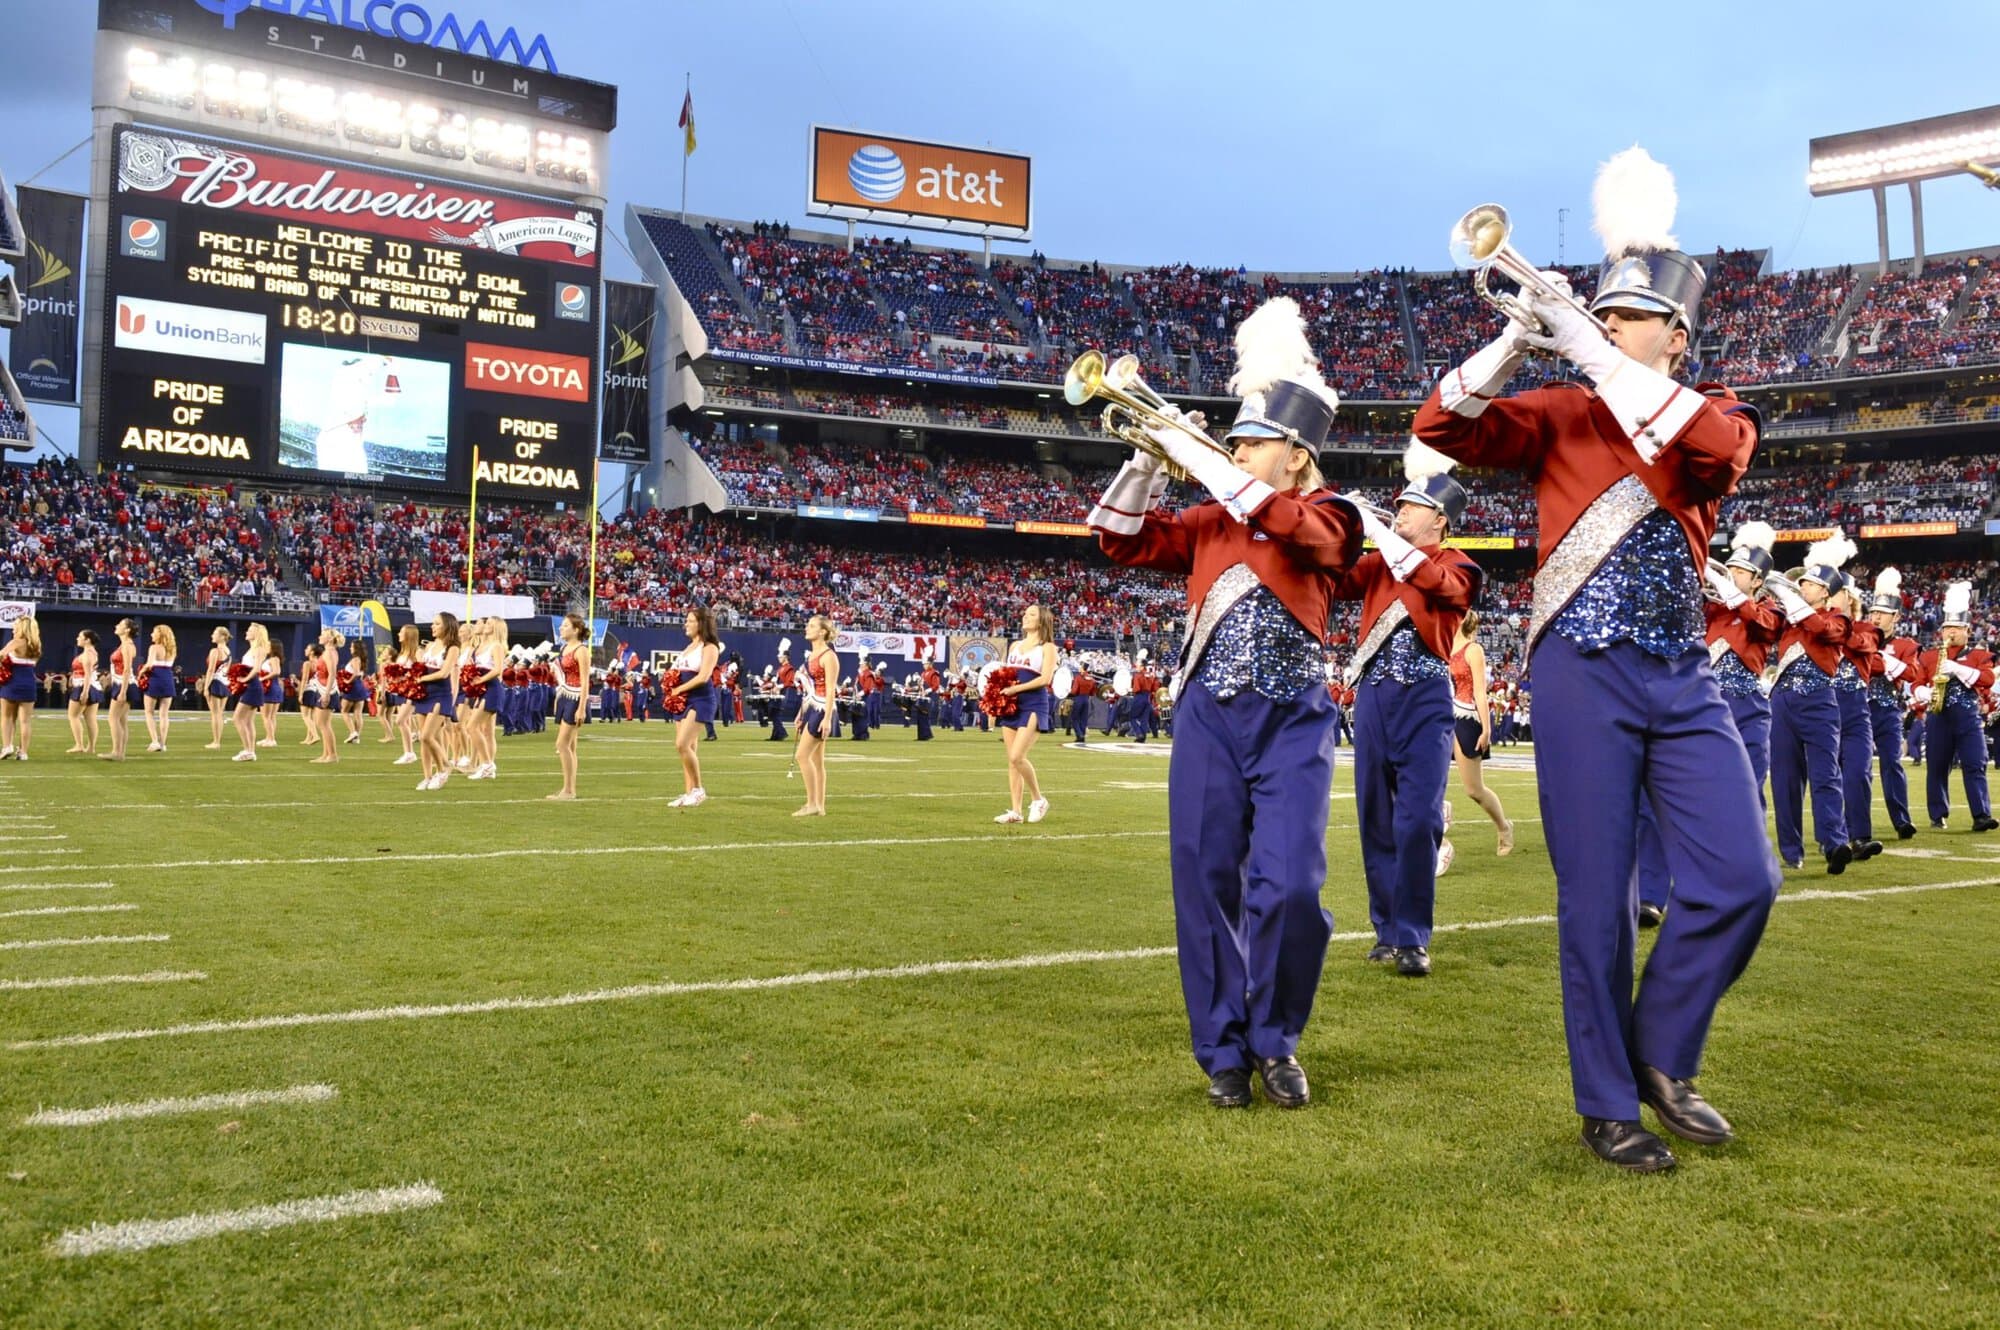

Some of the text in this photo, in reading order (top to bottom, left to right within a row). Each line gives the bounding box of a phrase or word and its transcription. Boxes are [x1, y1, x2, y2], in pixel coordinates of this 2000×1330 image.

[267, 25, 530, 95] STADIUM
[166, 153, 490, 225] Budweiser
[915, 162, 1005, 207] at&t
[277, 224, 463, 268] WELCOME TO THE
[497, 224, 593, 244] American Lager
[129, 247, 158, 257] pepsi
[198, 231, 528, 295] PACIFIC LIFE HOLIDAY BOWL
[210, 253, 518, 310] PRE-GAME SHOW PRESENTED BY THE
[187, 266, 536, 329] SYCUAN BAND OF THE KUMEYAAY NATION
[156, 319, 263, 348] UnionBank
[283, 303, 356, 335] 18:20
[361, 320, 419, 337] SYCUAN
[471, 356, 584, 391] TOYOTA
[604, 370, 647, 389] Sprint
[736, 352, 750, 360] FAN
[750, 354, 780, 363] CONDUCT
[807, 360, 823, 368] TEXT
[887, 368, 905, 376] YOUR
[906, 371, 937, 379] LOCATION
[153, 379, 224, 405] PRIDE
[172, 406, 204, 426] OF
[499, 417, 558, 440] PRIDE
[120, 426, 251, 460] ARIZONA
[515, 441, 542, 460] OF
[476, 460, 580, 490] ARIZONA
[910, 513, 986, 527] WELLS FARGO
[913, 637, 937, 660] N
